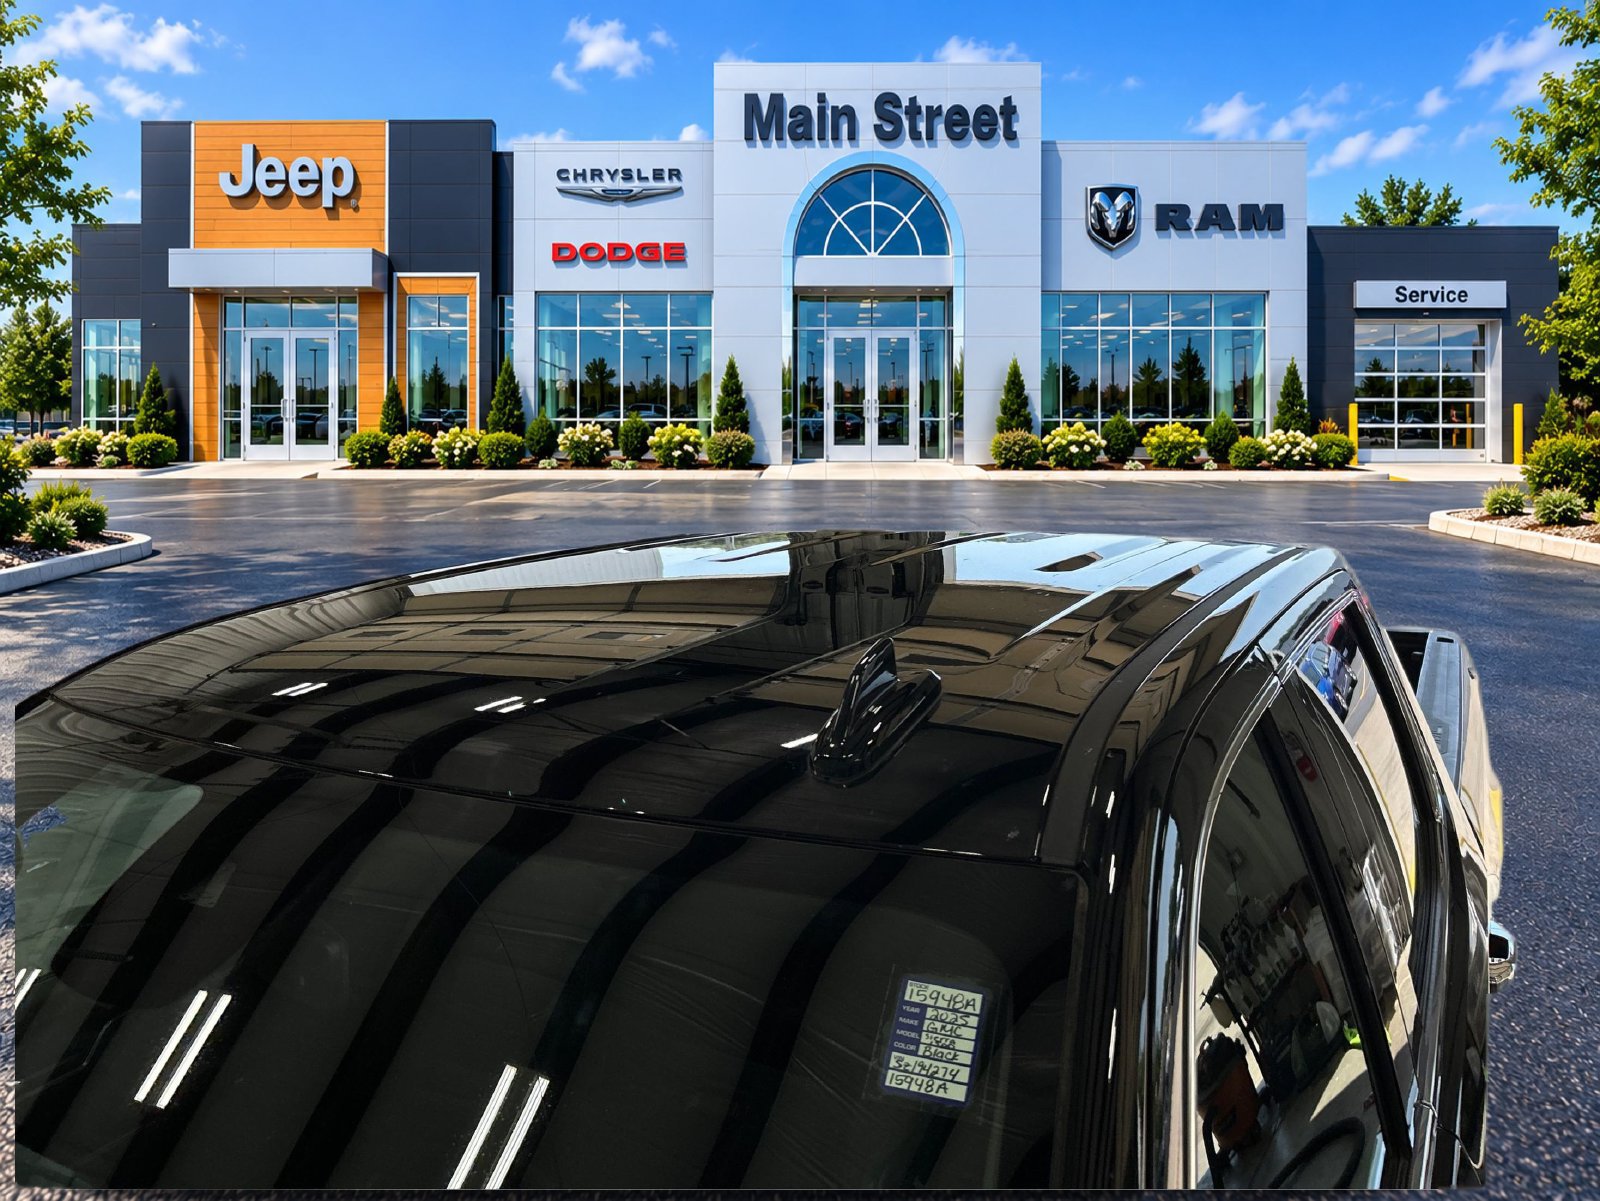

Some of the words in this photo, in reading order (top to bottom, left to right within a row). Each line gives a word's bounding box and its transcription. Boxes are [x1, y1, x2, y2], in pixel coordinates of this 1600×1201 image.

[744, 92, 857, 142] Main
[873, 91, 1018, 142] Street
[218, 143, 354, 208] Jeep
[556, 168, 683, 182] CHRYSLER
[1155, 203, 1284, 231] RAM
[552, 242, 687, 262] DODGE
[1395, 285, 1468, 303] Service
[908, 988, 976, 1012] 15948A
[902, 1005, 921, 1013] YEAR
[929, 1008, 970, 1026] 2025
[896, 1029, 920, 1039] MODEL
[899, 1017, 918, 1026] MAKE
[927, 1022, 963, 1037] GMC
[893, 1041, 917, 1051] COLOR
[922, 1045, 960, 1061] Black
[889, 1073, 948, 1094] 15948A
